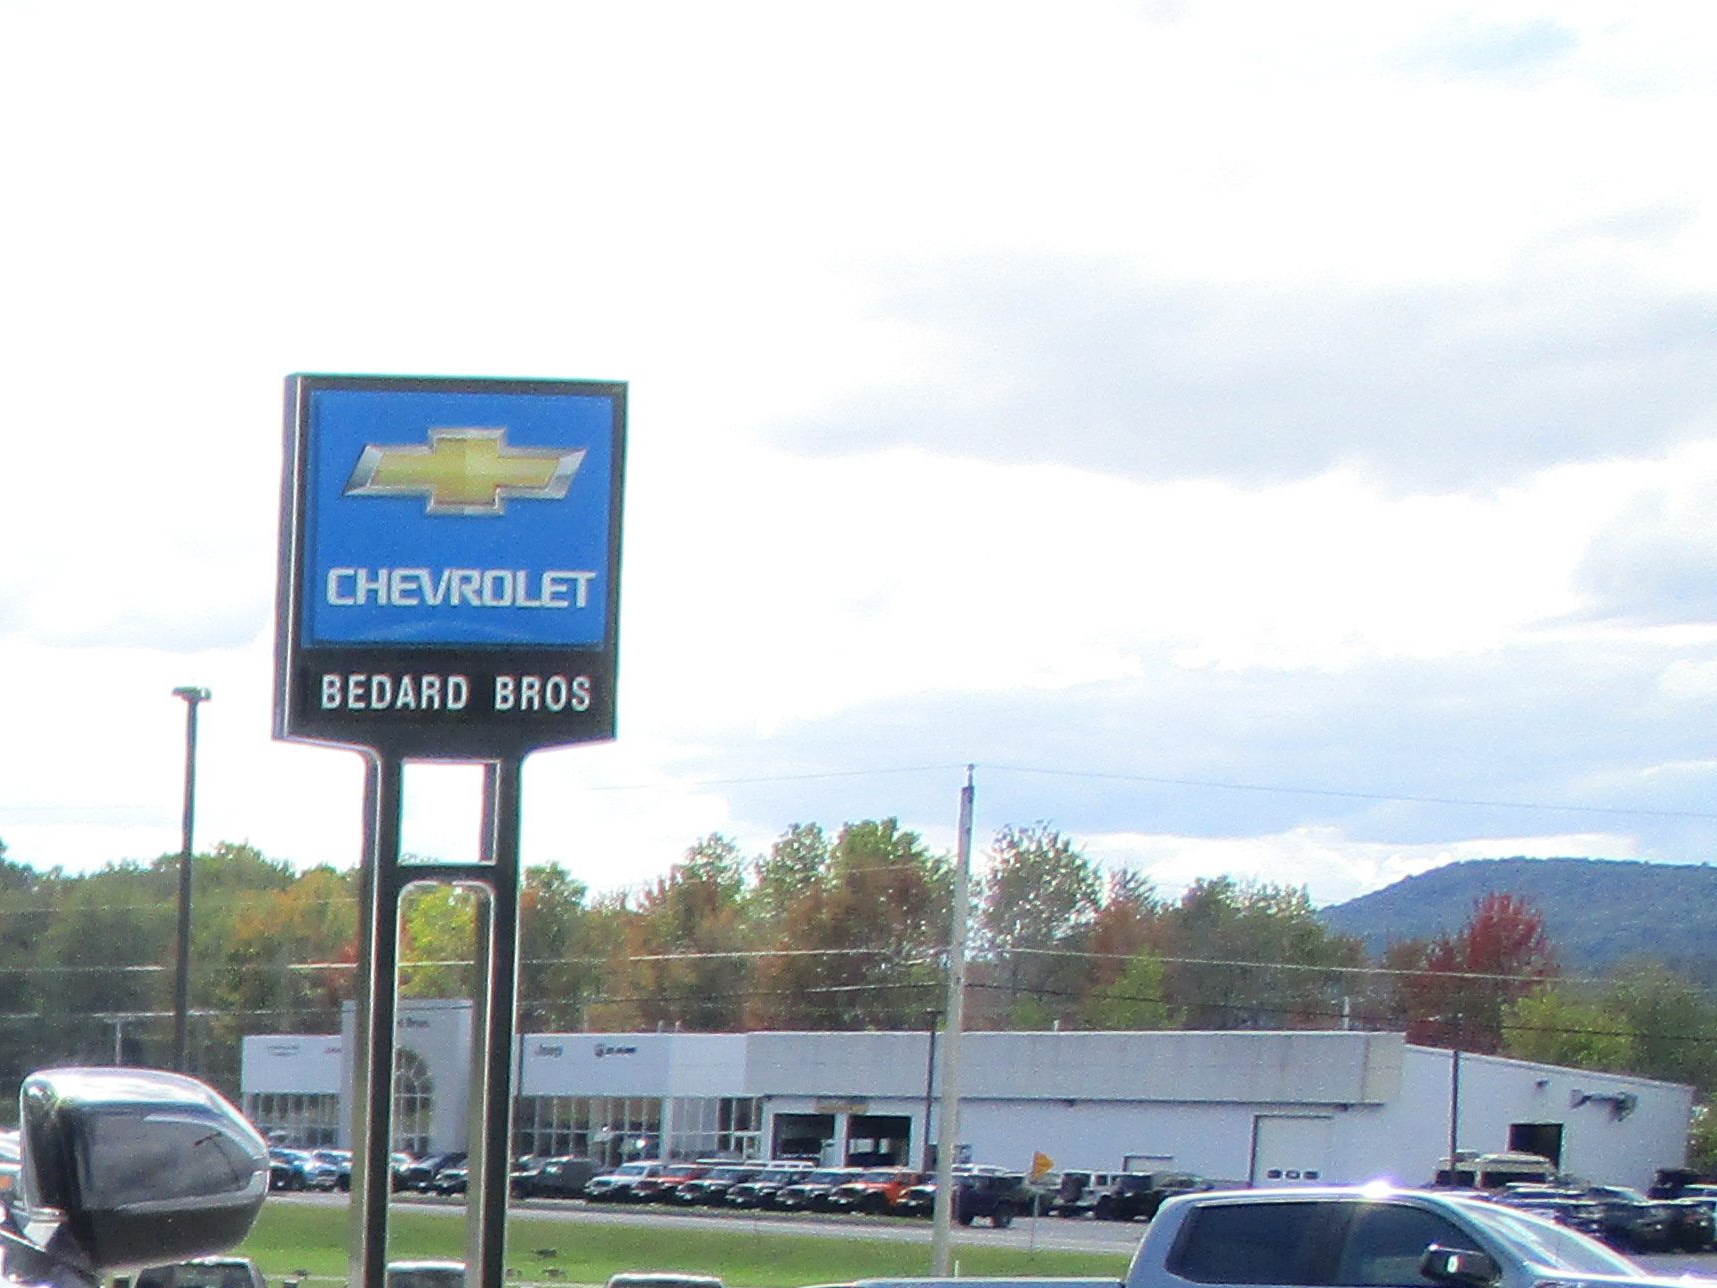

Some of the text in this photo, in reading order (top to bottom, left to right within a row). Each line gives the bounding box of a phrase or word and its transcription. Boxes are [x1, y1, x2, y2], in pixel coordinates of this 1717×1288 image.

[326, 567, 597, 608] CHEVROLET
[321, 673, 591, 713] BEDARD BROS
